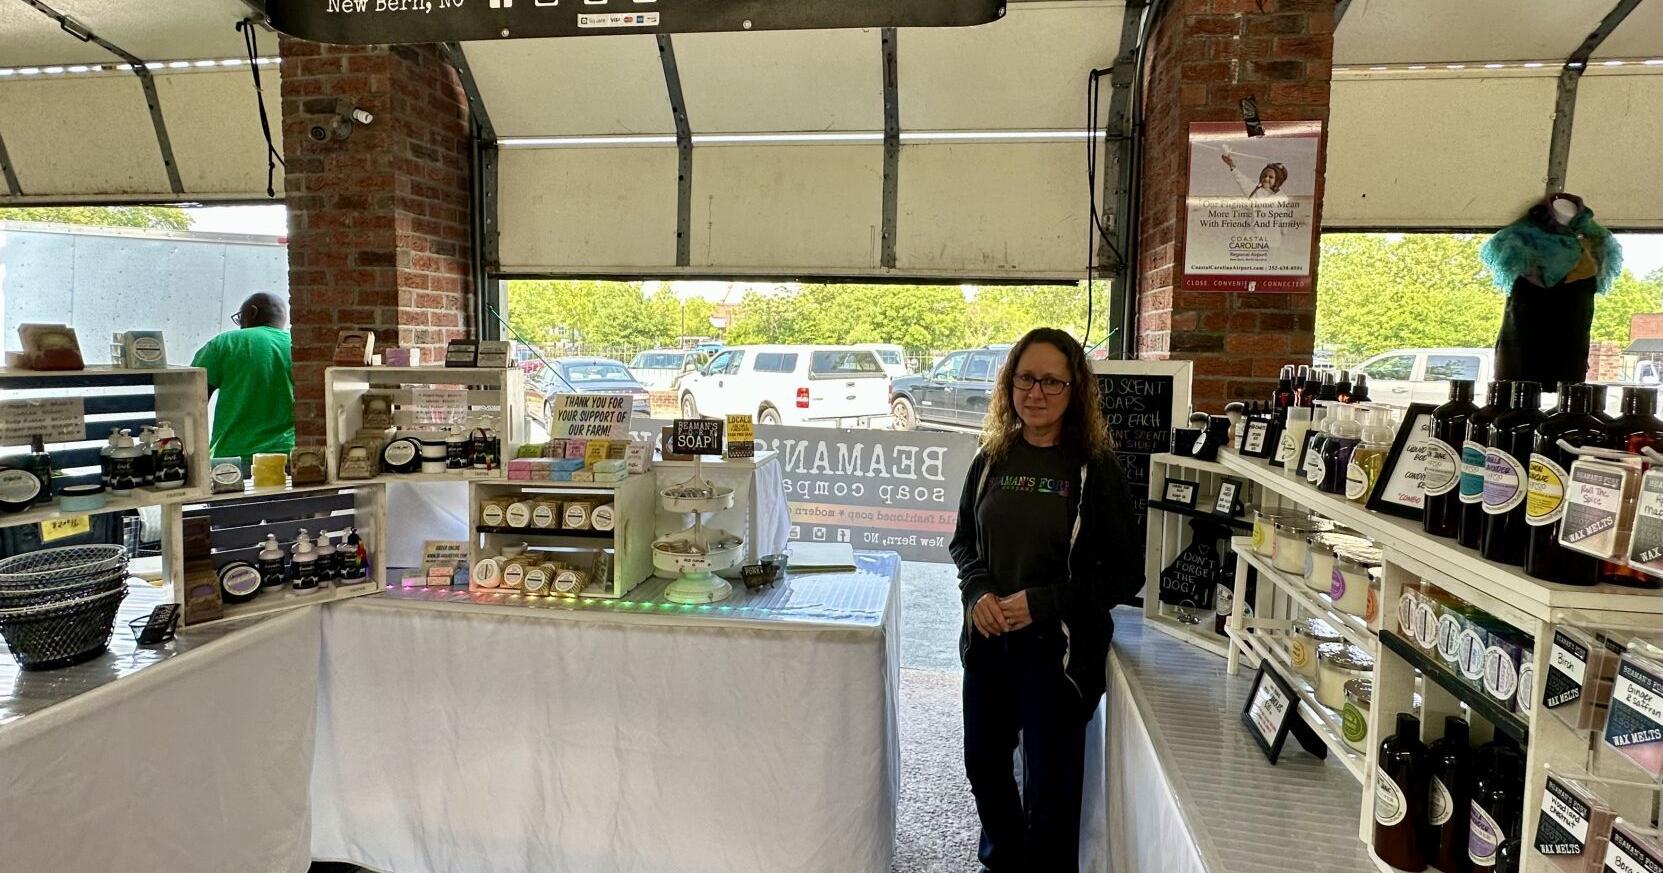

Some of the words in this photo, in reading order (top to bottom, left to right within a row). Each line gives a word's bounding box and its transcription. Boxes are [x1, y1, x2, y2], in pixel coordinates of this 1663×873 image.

[326, 0, 367, 13] New
[375, 0, 432, 14] Bern,
[1277, 201, 1300, 209] Mean
[1208, 210, 1230, 218] More
[1231, 210, 1252, 218] Time
[1256, 210, 1266, 218] To
[1268, 210, 1294, 220] Spend
[1200, 219, 1219, 228] With
[1221, 219, 1251, 228] Friends
[1254, 219, 1270, 228] And
[1228, 242, 1269, 250] CAROLINA
[1120, 377, 1167, 396] SCENT
[564, 395, 590, 409] THANK
[591, 396, 606, 409] YOU
[608, 397, 624, 409] FOR
[557, 409, 578, 423] YOUR
[579, 410, 615, 423] SUPPORT
[616, 411, 628, 423] OF
[1128, 409, 1161, 428] EACH
[568, 424, 584, 436] OUR
[586, 424, 612, 437] FARM!
[678, 421, 718, 431] BEAMAN'S
[678, 435, 712, 448] SOAP
[1568, 529, 1586, 543] WAX
[1586, 516, 1614, 535] MELTS
[1183, 551, 1216, 569] DON'T
[1640, 546, 1662, 562] WAX
[1174, 570, 1199, 584] THE
[1176, 559, 1216, 581] FORGET
[1162, 576, 1197, 596] DOG!
[1547, 695, 1561, 708] WAX
[1560, 688, 1581, 704] MELTS
[1611, 734, 1632, 747] WAX
[1632, 728, 1663, 744] MELTS
[1539, 843, 1553, 855] WAX
[1555, 843, 1581, 854] MELTS
